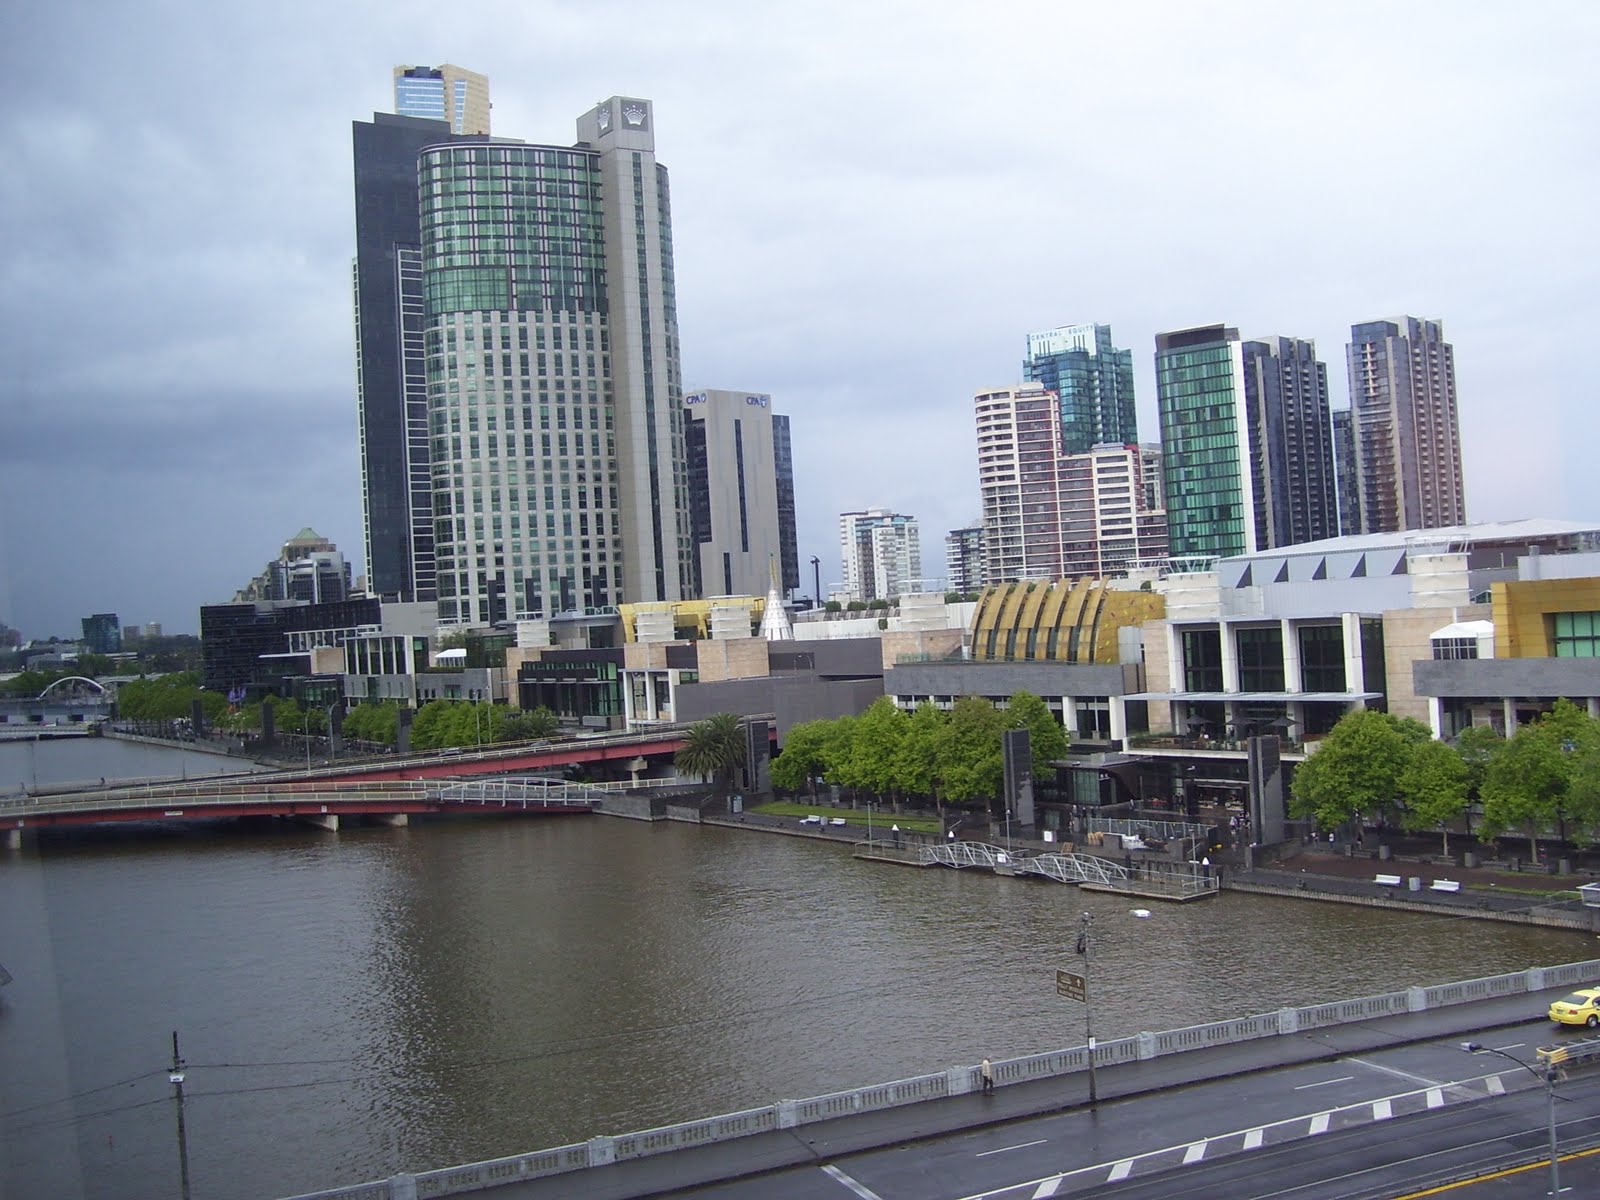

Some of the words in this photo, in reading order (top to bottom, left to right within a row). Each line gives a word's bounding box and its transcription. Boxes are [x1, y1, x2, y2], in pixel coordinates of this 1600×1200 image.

[1031, 331, 1062, 340] CENTRAL
[1068, 325, 1094, 335] EQUITY
[686, 394, 700, 404] CPA
[746, 396, 760, 405] CPA
